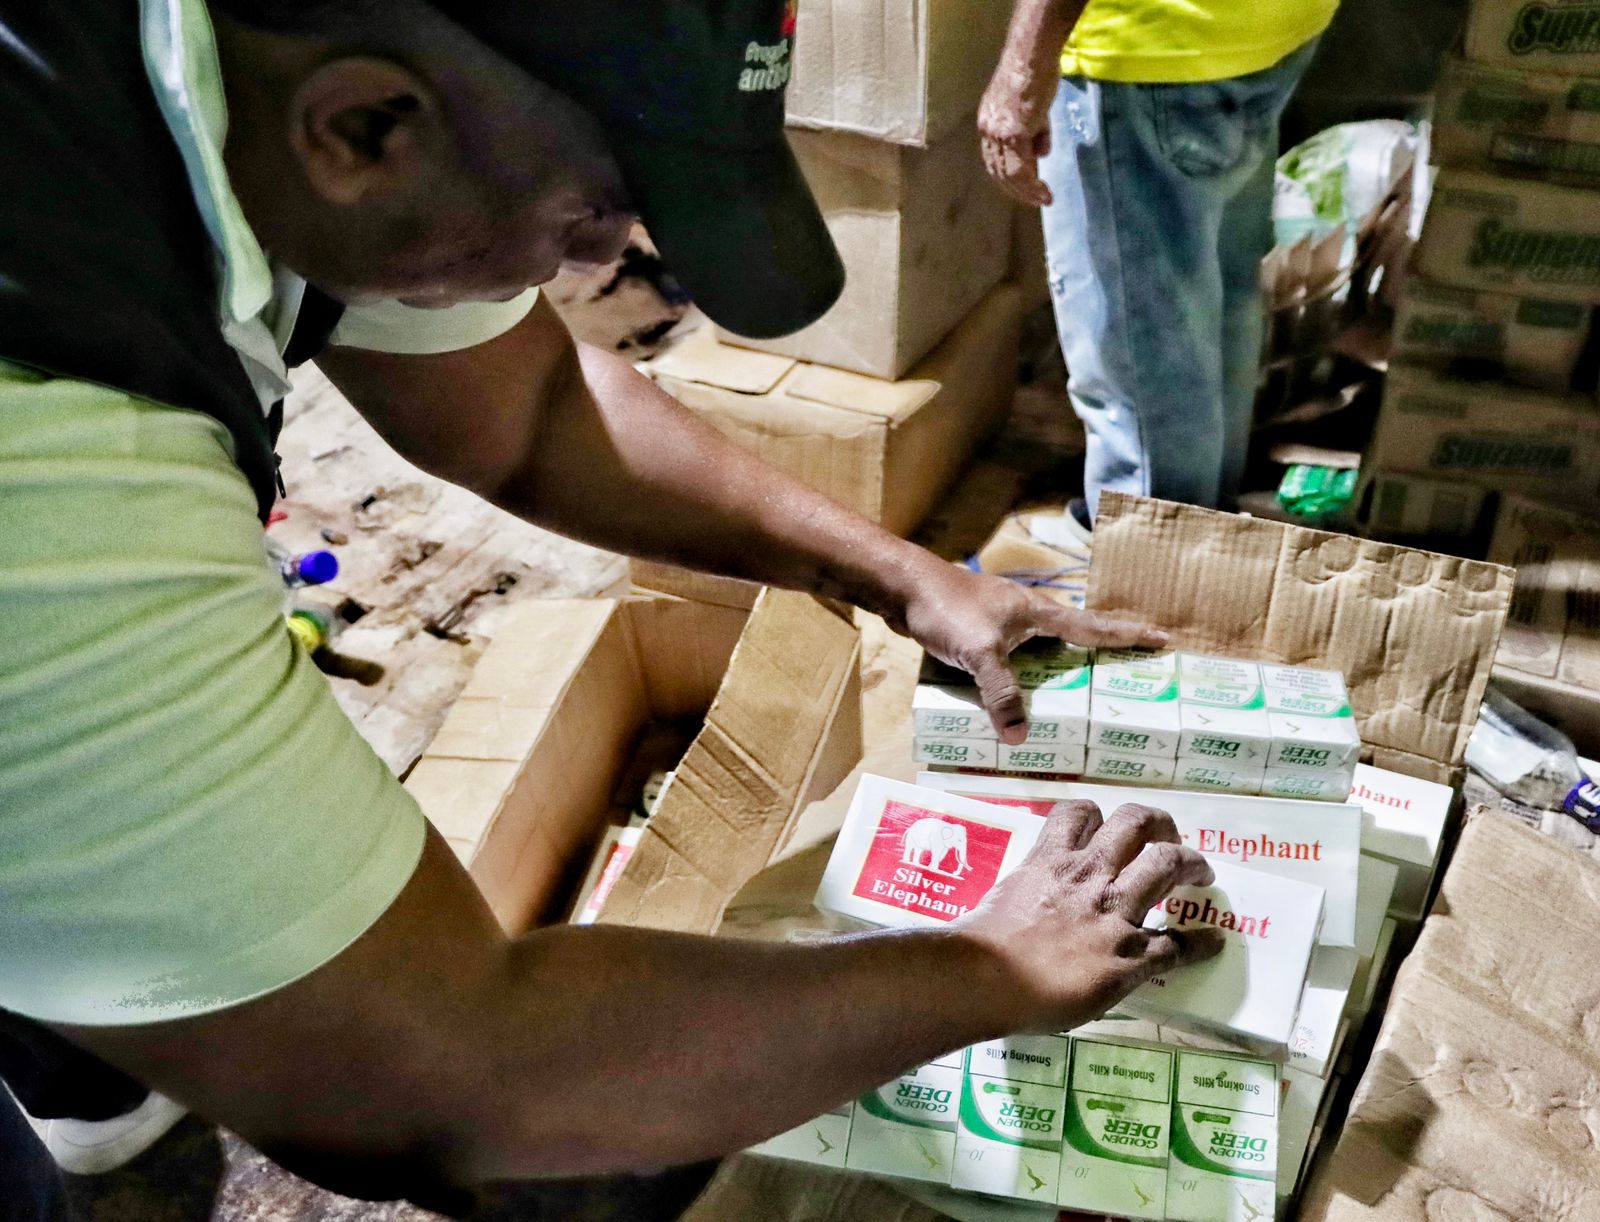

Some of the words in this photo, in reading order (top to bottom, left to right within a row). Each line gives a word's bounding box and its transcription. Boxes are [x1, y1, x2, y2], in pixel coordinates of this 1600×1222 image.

[1513, 6, 1600, 49] Supr
[1100, 730, 1151, 744] DEER
[1190, 737, 1241, 752] DEER
[923, 744, 969, 755] DEER
[1009, 751, 1057, 762] DEER
[1280, 746, 1332, 760] DEER
[1098, 759, 1147, 771] DEER
[1197, 828, 1323, 862] Elephant
[893, 867, 957, 896] Silver
[870, 879, 969, 916] Elephant
[1151, 896, 1272, 940] ephant
[986, 1047, 1007, 1060] Kills
[1010, 1049, 1052, 1067] Smoking
[1089, 1063, 1110, 1076] Kills
[1113, 1064, 1155, 1083] Smoking
[1193, 1075, 1215, 1088] Kills
[1216, 1075, 1260, 1095] Smoking
[896, 1083, 952, 1103] DEER
[894, 1098, 948, 1113] GOLDEN
[999, 1102, 1056, 1123] DEER
[997, 1117, 1052, 1133] GOLDEN
[1103, 1118, 1161, 1139] DEER
[1101, 1133, 1158, 1149] GOLDEN
[1210, 1130, 1268, 1152] DEER
[969, 1149, 985, 1161] 10
[1208, 1146, 1265, 1162] GOLDEN
[1074, 1166, 1090, 1179] 10
